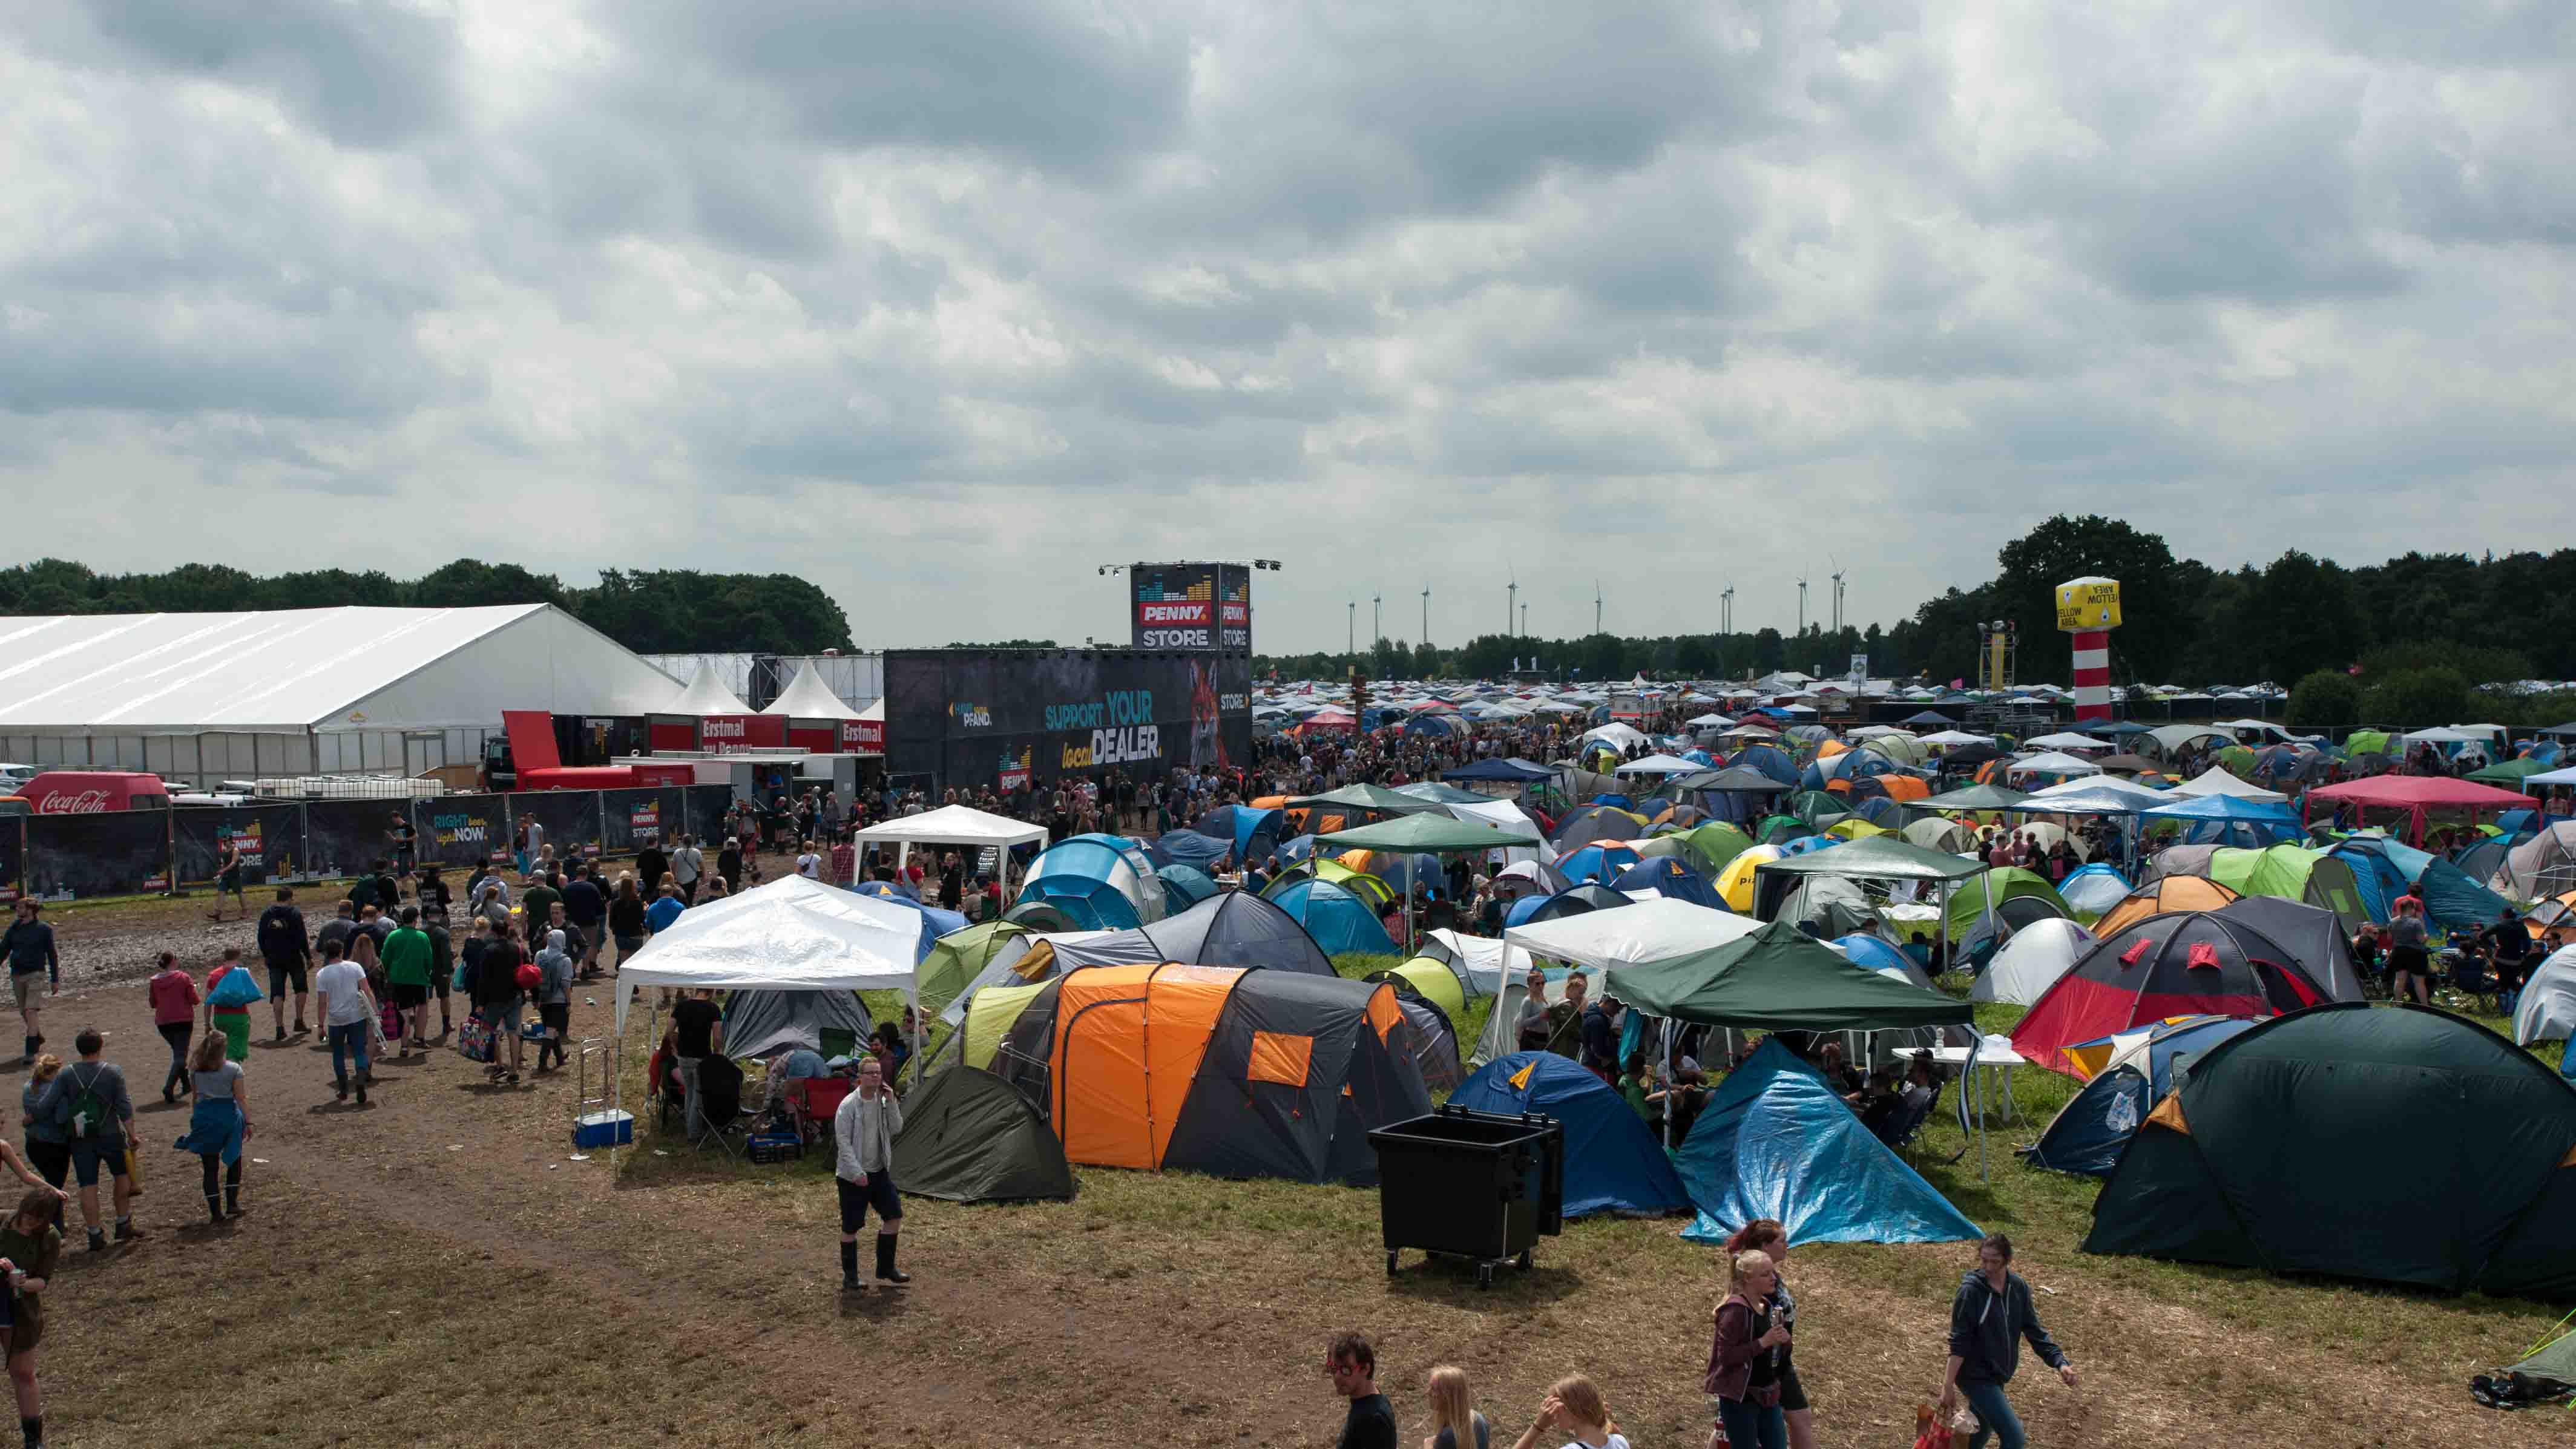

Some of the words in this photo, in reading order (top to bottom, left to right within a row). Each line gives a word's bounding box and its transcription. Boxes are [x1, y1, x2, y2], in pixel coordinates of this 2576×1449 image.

[1143, 630, 1208, 646] STORE
[1224, 629, 1246, 646] STORE
[1046, 703, 1104, 731] SUPPORT
[1106, 690, 1152, 726] YOUR
[703, 718, 745, 737] Erstmal
[843, 723, 882, 743] Erstmal
[435, 814, 468, 829] RIGHT
[633, 827, 659, 838] STORE
